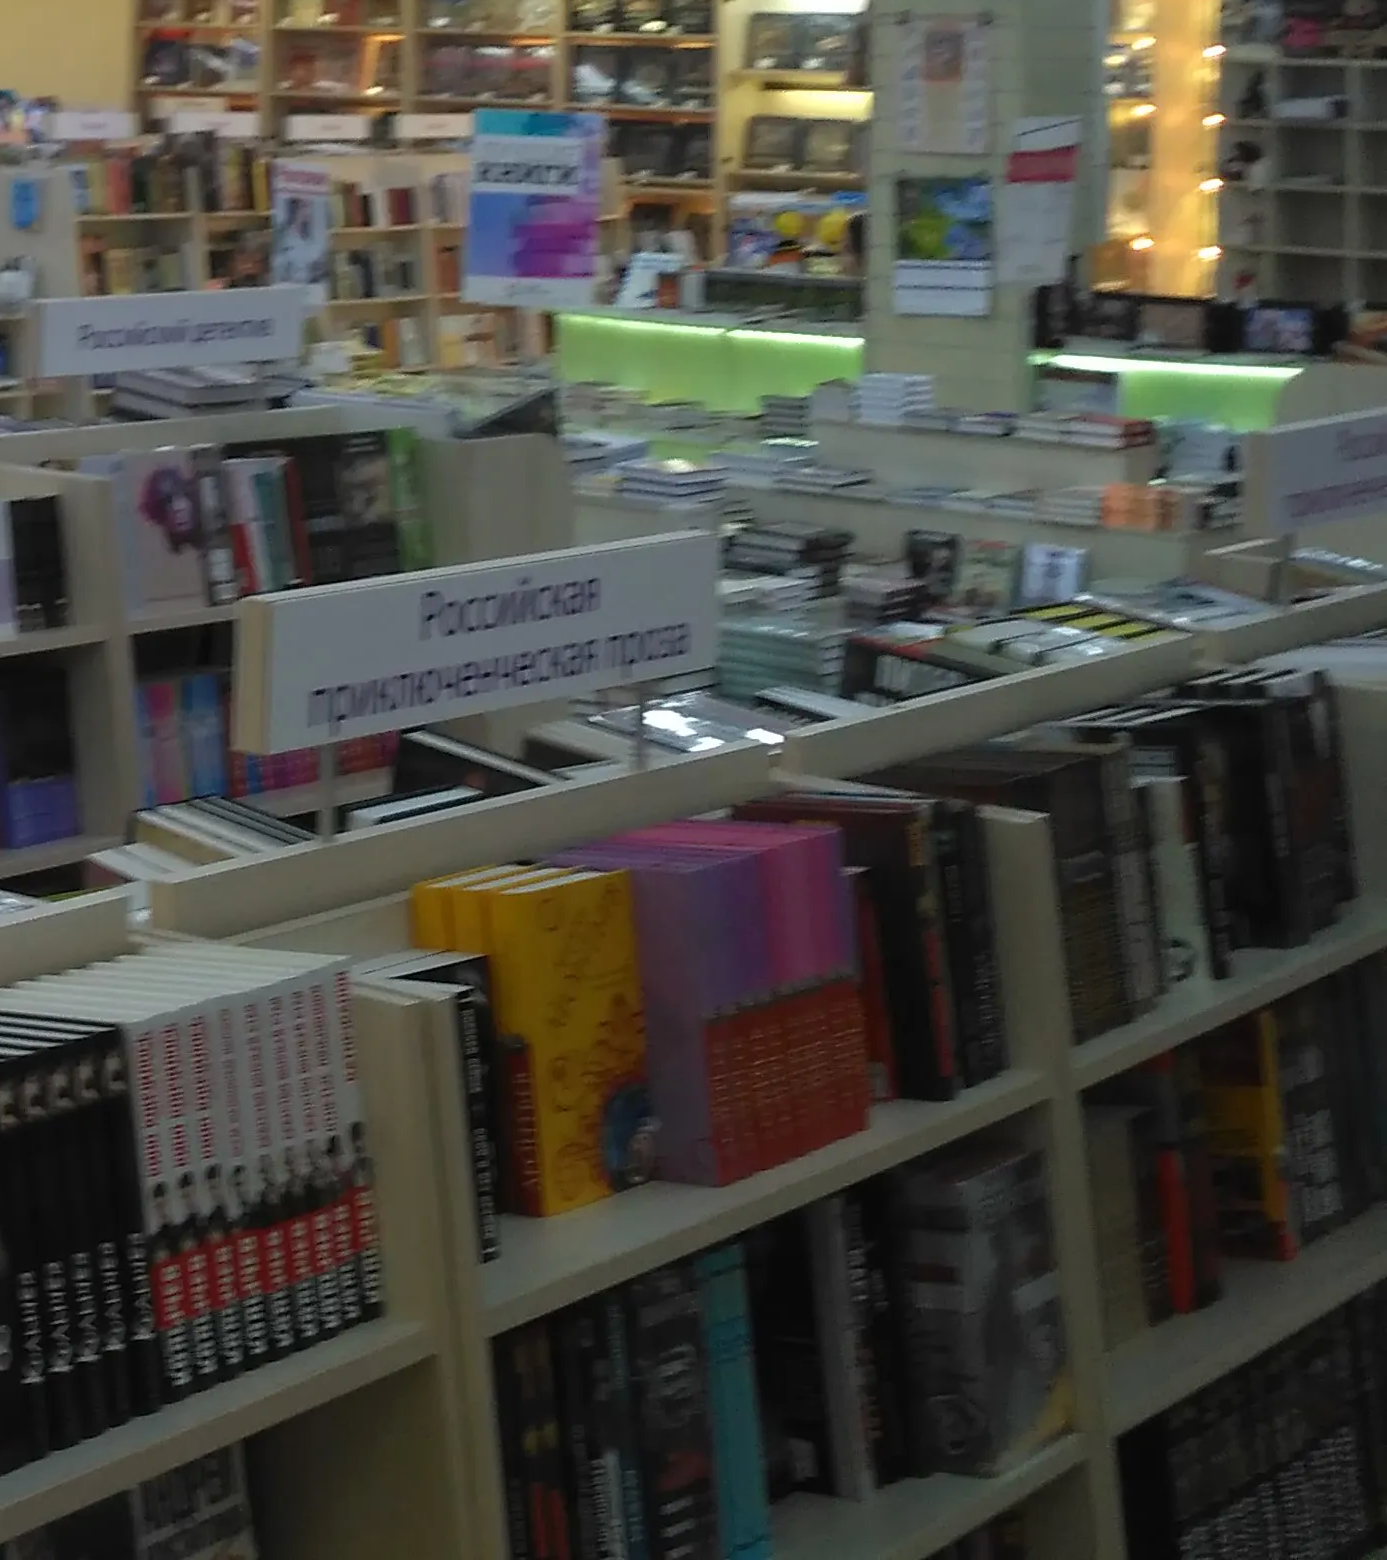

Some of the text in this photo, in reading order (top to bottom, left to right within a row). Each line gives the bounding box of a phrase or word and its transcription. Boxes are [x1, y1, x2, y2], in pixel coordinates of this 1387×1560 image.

[419, 576, 602, 640] Российская
[308, 622, 693, 734] приключенческая проза
